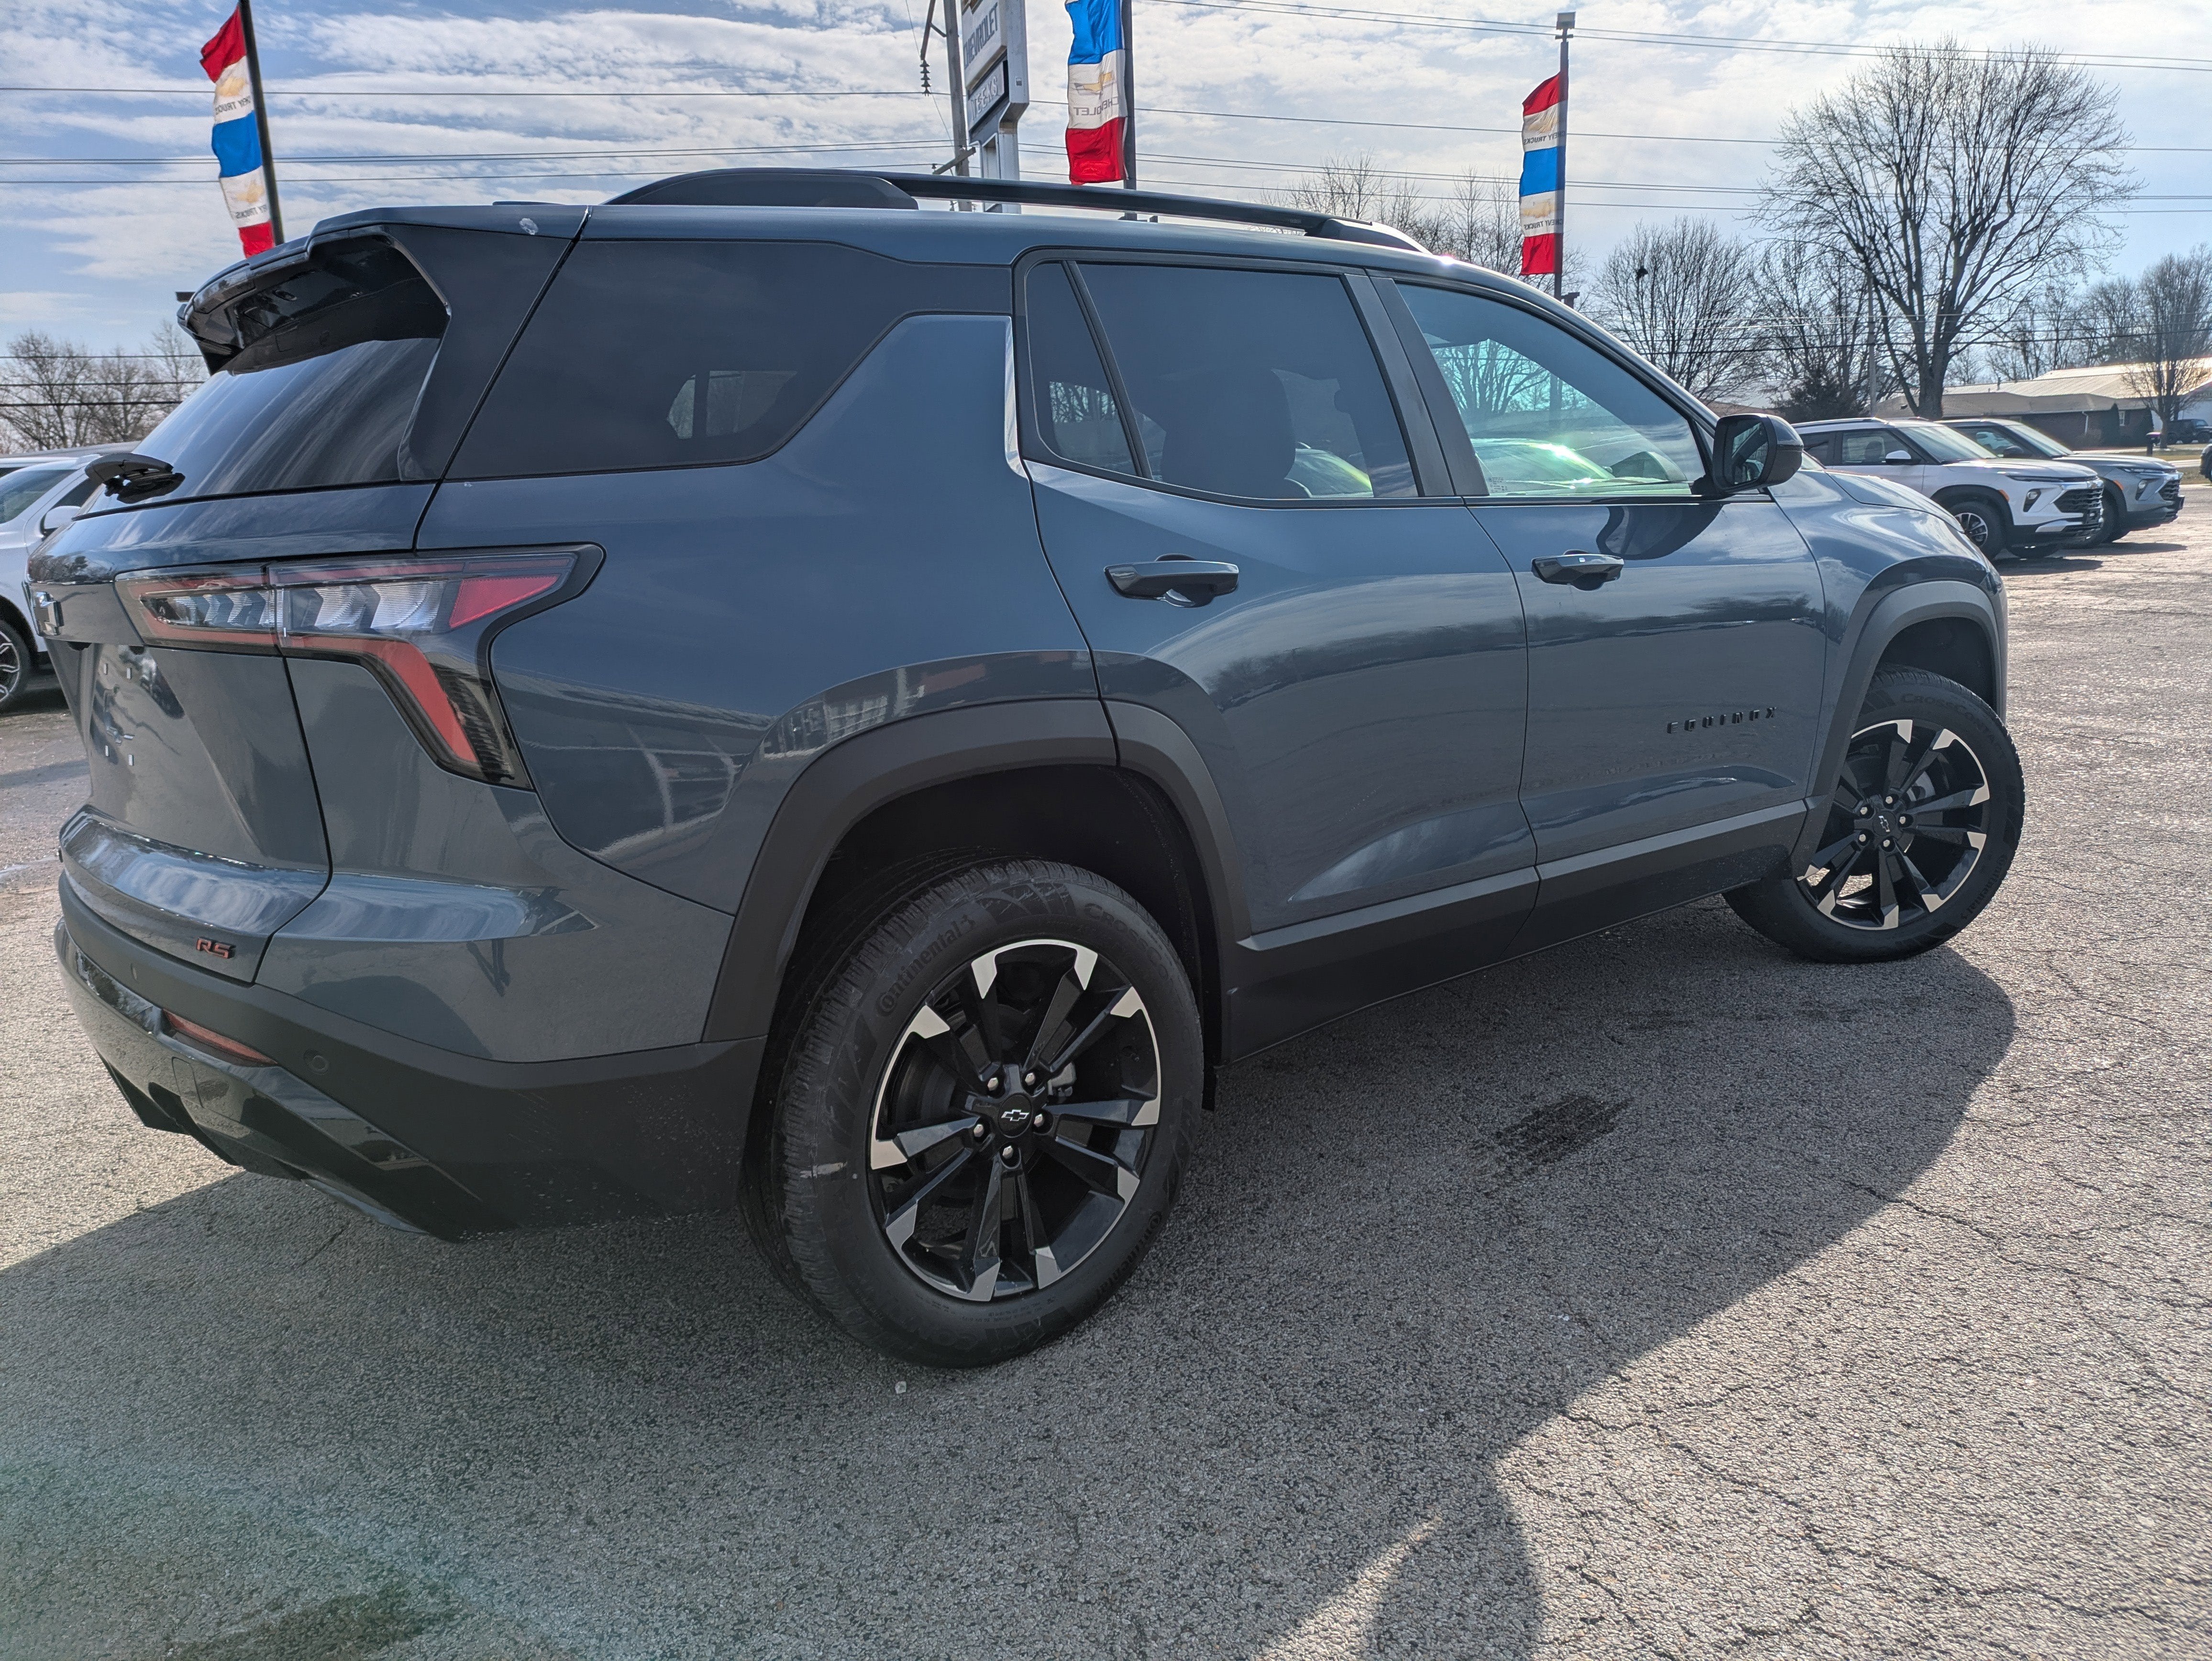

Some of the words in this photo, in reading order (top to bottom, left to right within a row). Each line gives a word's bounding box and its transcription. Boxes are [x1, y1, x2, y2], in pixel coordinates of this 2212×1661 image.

[963, 1, 998, 70] CHEVROLET
[1666, 706, 1777, 734] EQUINOX
[196, 937, 231, 959] RS
[876, 920, 963, 1017] Continental
